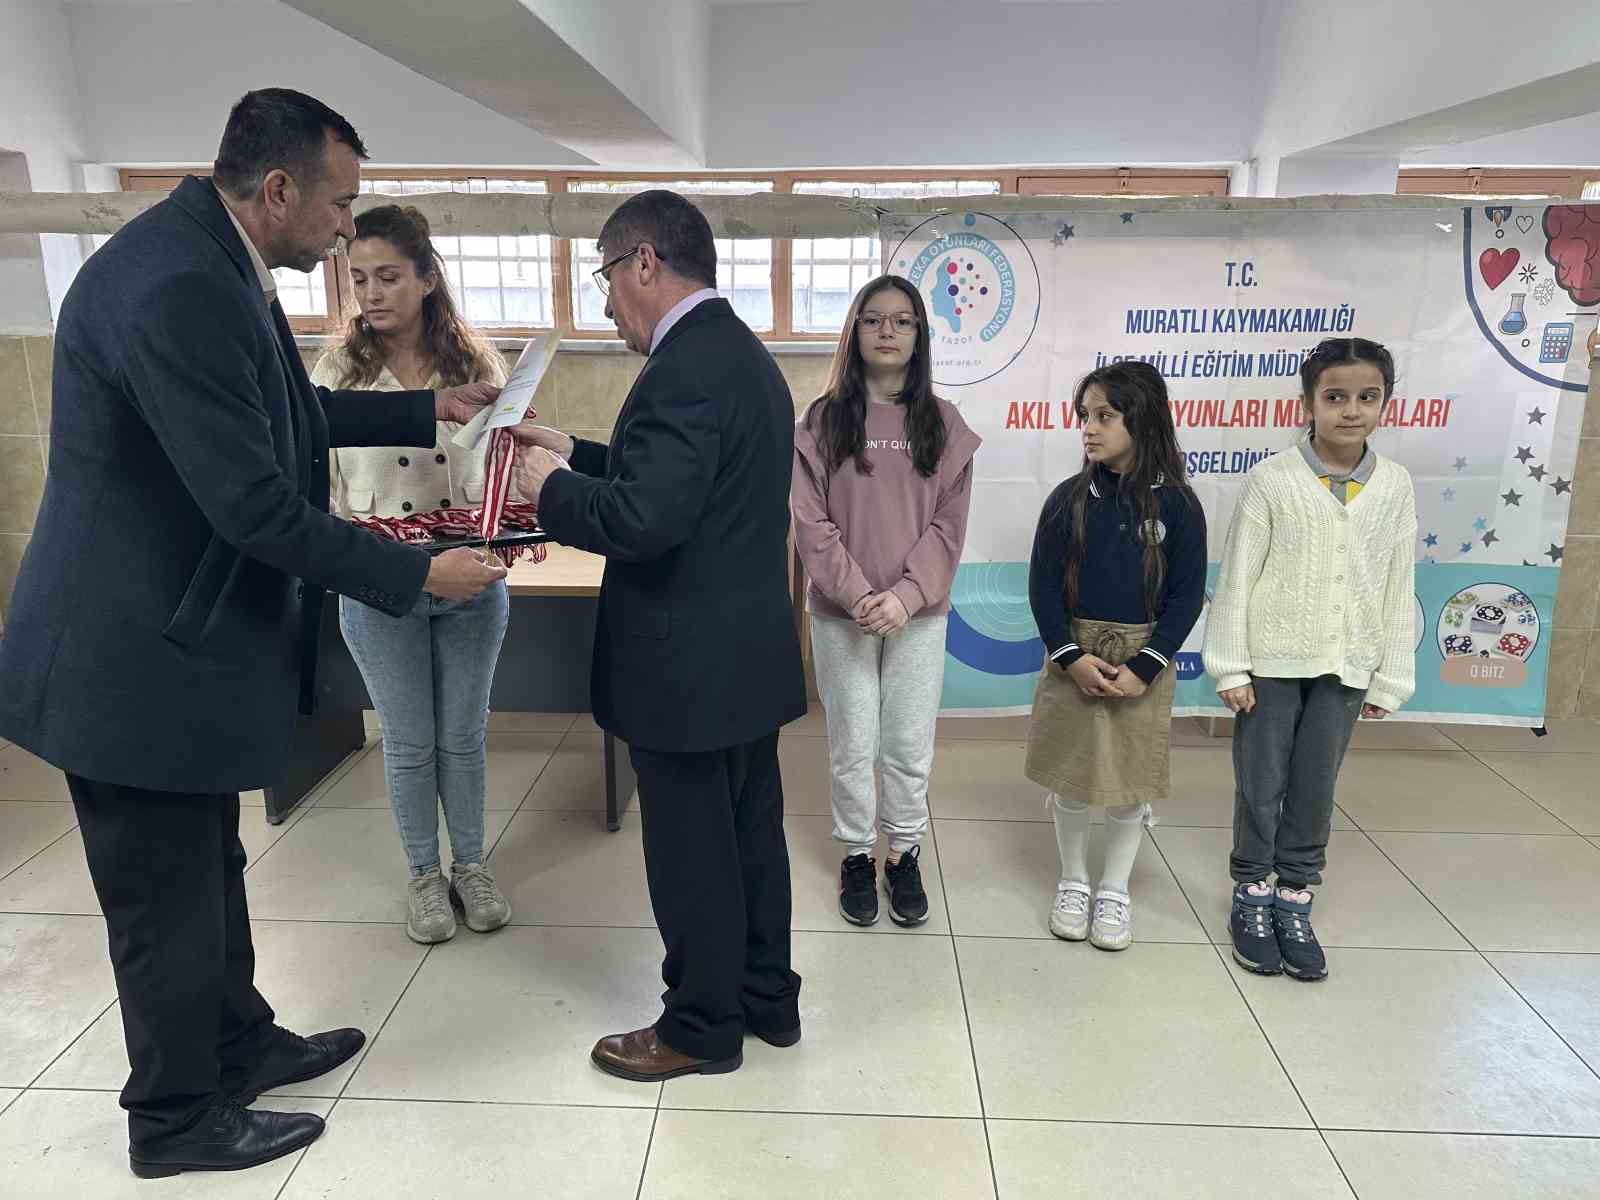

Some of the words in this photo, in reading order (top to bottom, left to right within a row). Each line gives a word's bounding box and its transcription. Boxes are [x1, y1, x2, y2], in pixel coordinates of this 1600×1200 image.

[1225, 262, 1258, 287] T.C.
[983, 248, 1015, 341] FEDERASYONU
[1126, 308, 1207, 334] MURATLI
[1212, 303, 1356, 333] KAYMAKAMLIĞI
[1191, 349, 1253, 378] EĞİTİM
[1006, 401, 1055, 430] AKIL
[1061, 400, 1084, 430] V
[1170, 399, 1269, 428] YUNLARI
[864, 440, 888, 449] N'T
[890, 440, 911, 450] QUI
